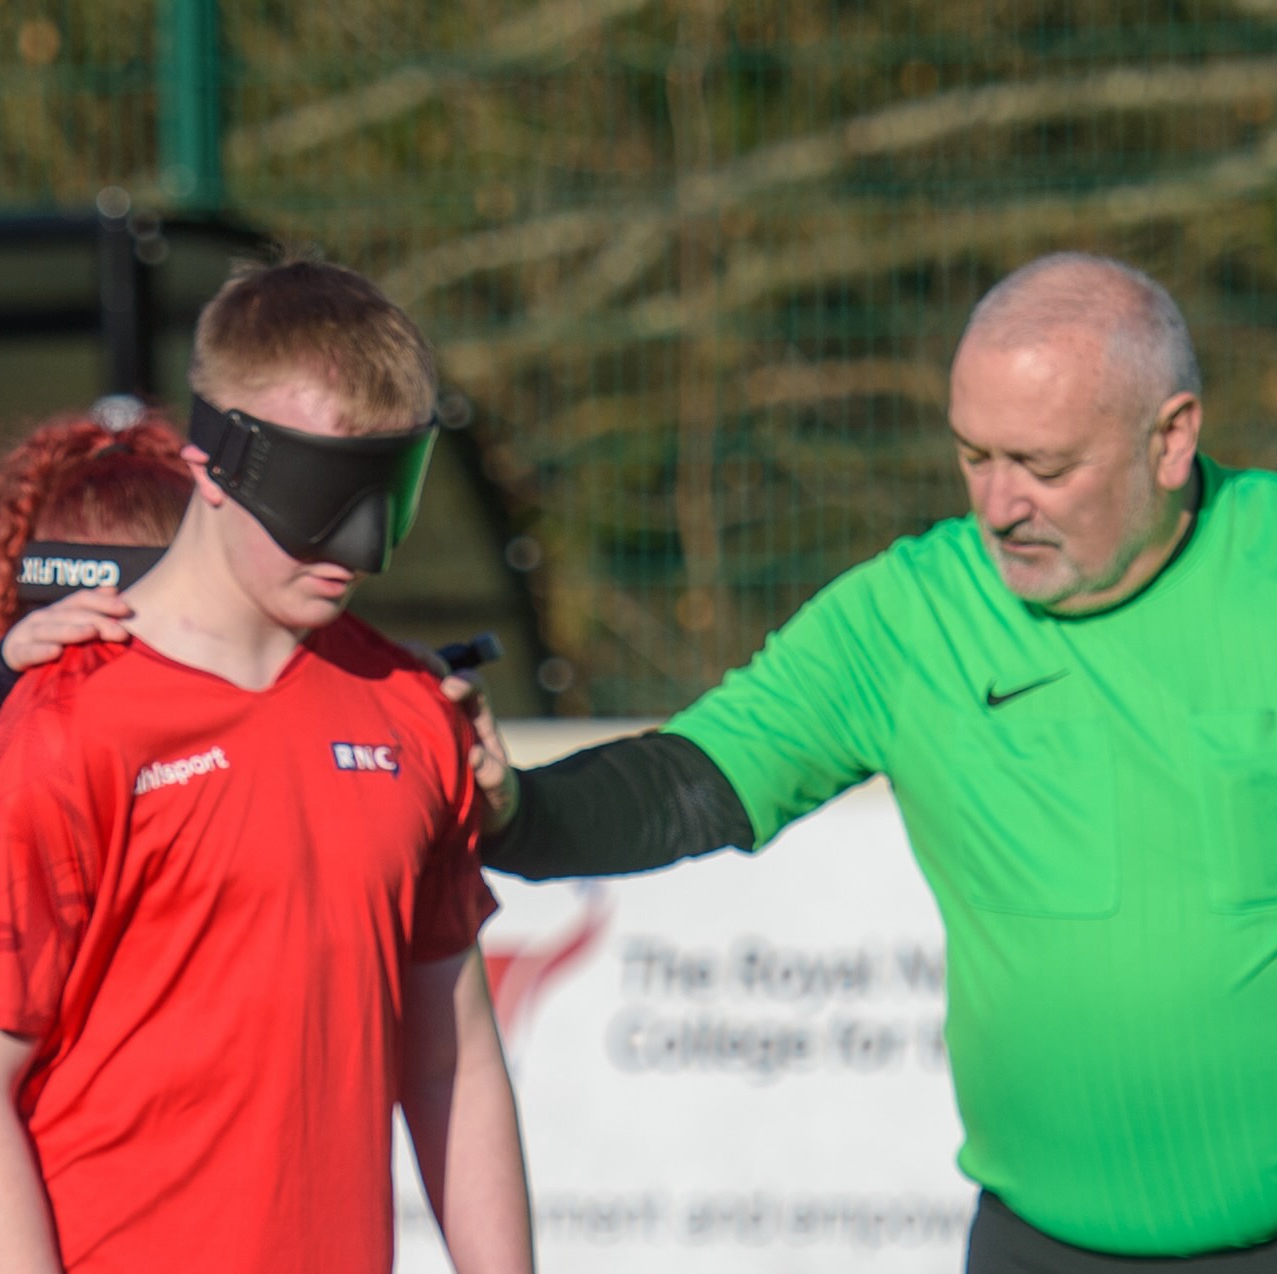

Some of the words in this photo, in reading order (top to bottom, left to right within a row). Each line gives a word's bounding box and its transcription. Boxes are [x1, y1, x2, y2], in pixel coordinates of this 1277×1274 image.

[332, 743, 397, 771] RNC
[619, 937, 714, 992] The
[732, 937, 875, 1006] Royal
[610, 1010, 810, 1080] College
[830, 1012, 906, 1074] for
